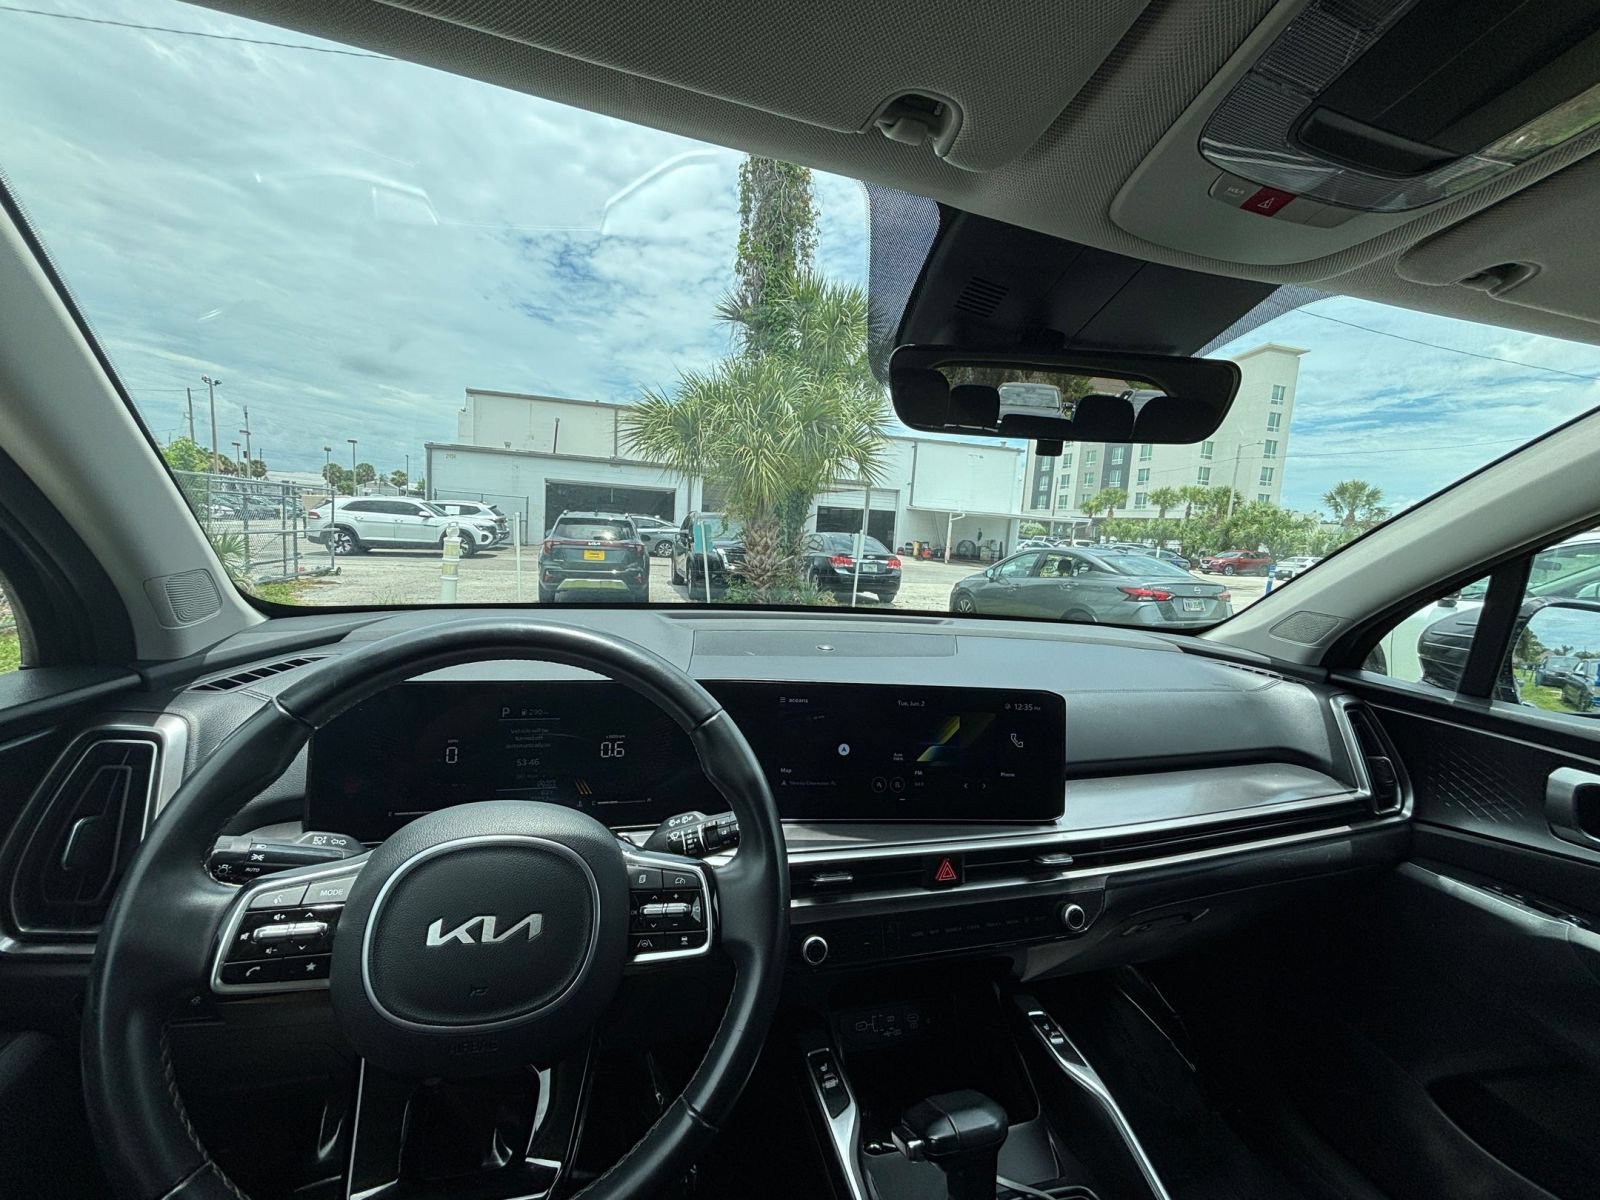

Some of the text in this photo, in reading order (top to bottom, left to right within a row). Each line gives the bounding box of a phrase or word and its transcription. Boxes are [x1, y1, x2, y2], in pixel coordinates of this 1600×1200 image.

[502, 707, 511, 718] P
[1014, 703, 1033, 711] 12:35
[445, 746, 458, 764] 0
[600, 741, 625, 758] 0.6
[320, 888, 344, 897] MODE
[426, 913, 543, 946] KIA
